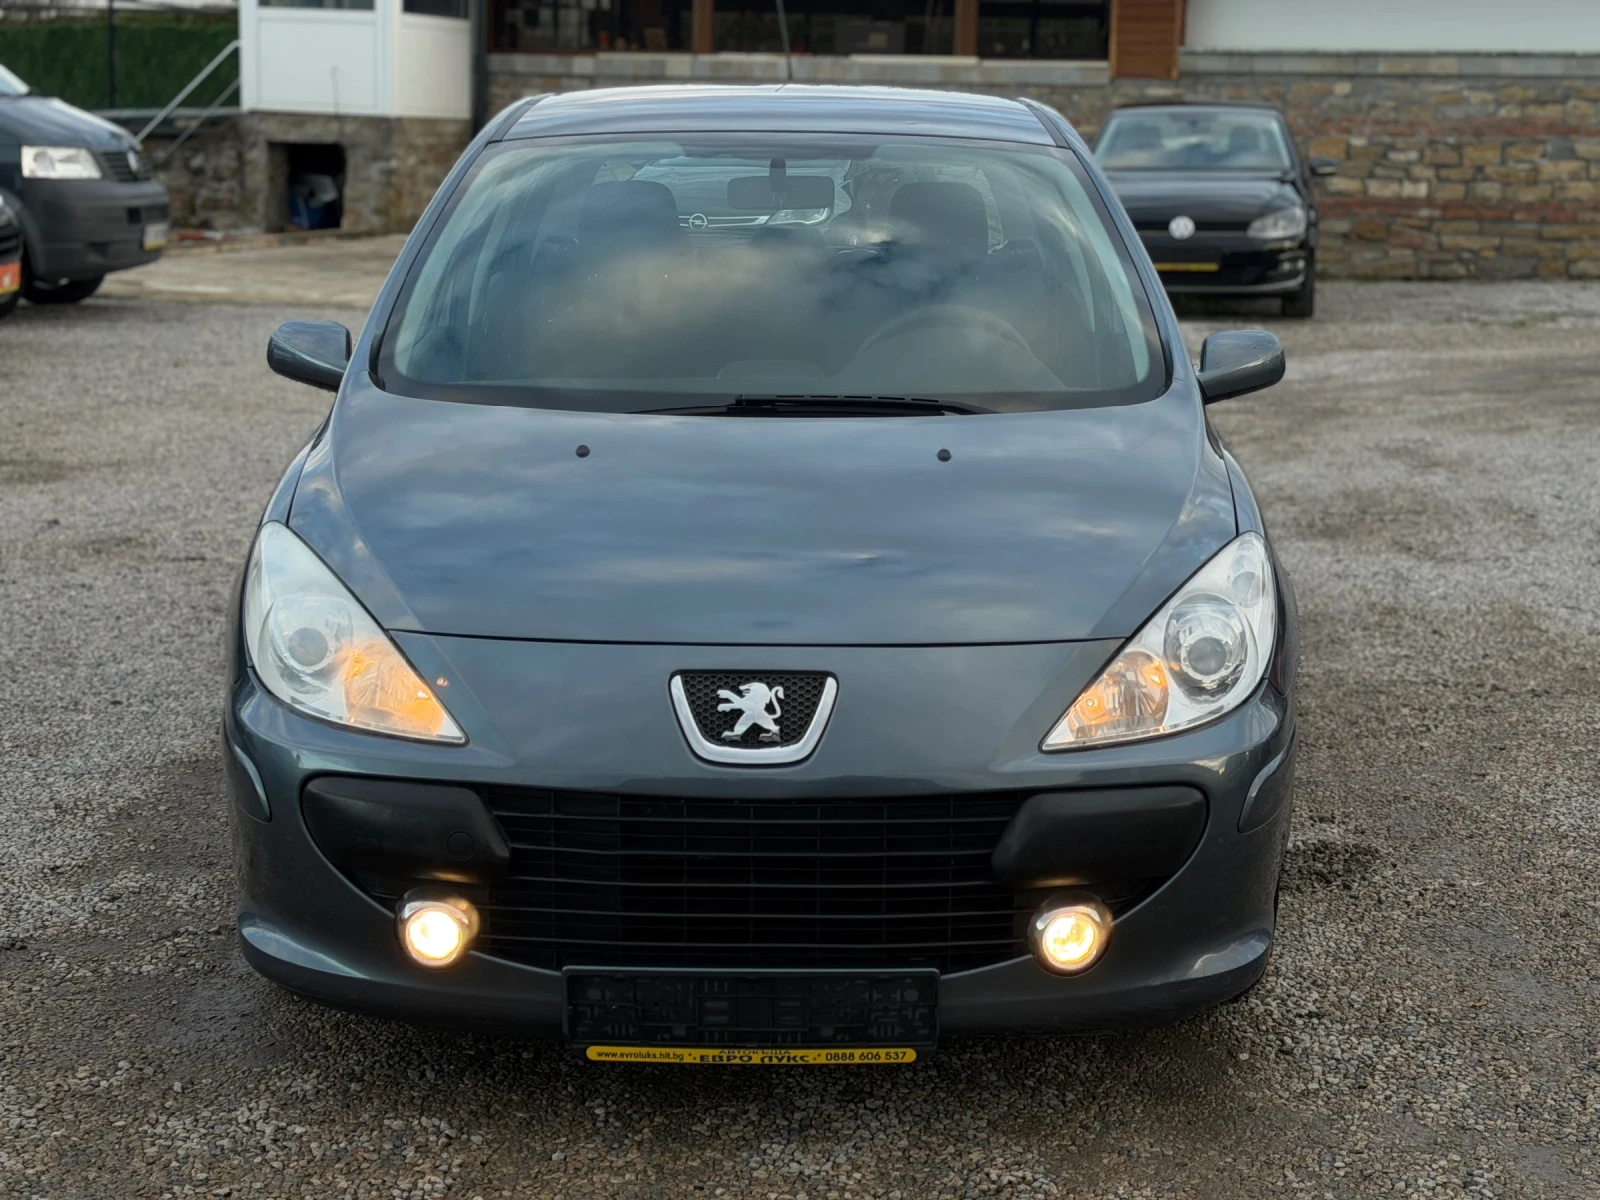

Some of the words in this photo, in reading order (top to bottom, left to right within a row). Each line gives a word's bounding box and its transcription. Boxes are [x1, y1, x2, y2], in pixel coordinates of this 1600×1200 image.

[596, 1051, 684, 1061] www.evroluks.hit.bg
[699, 1054, 753, 1063] ЕВРО
[760, 1055, 810, 1063] ЛУКС
[825, 1052, 855, 1062] 0888
[858, 1051, 881, 1061] 606
[885, 1051, 907, 1061] 537
